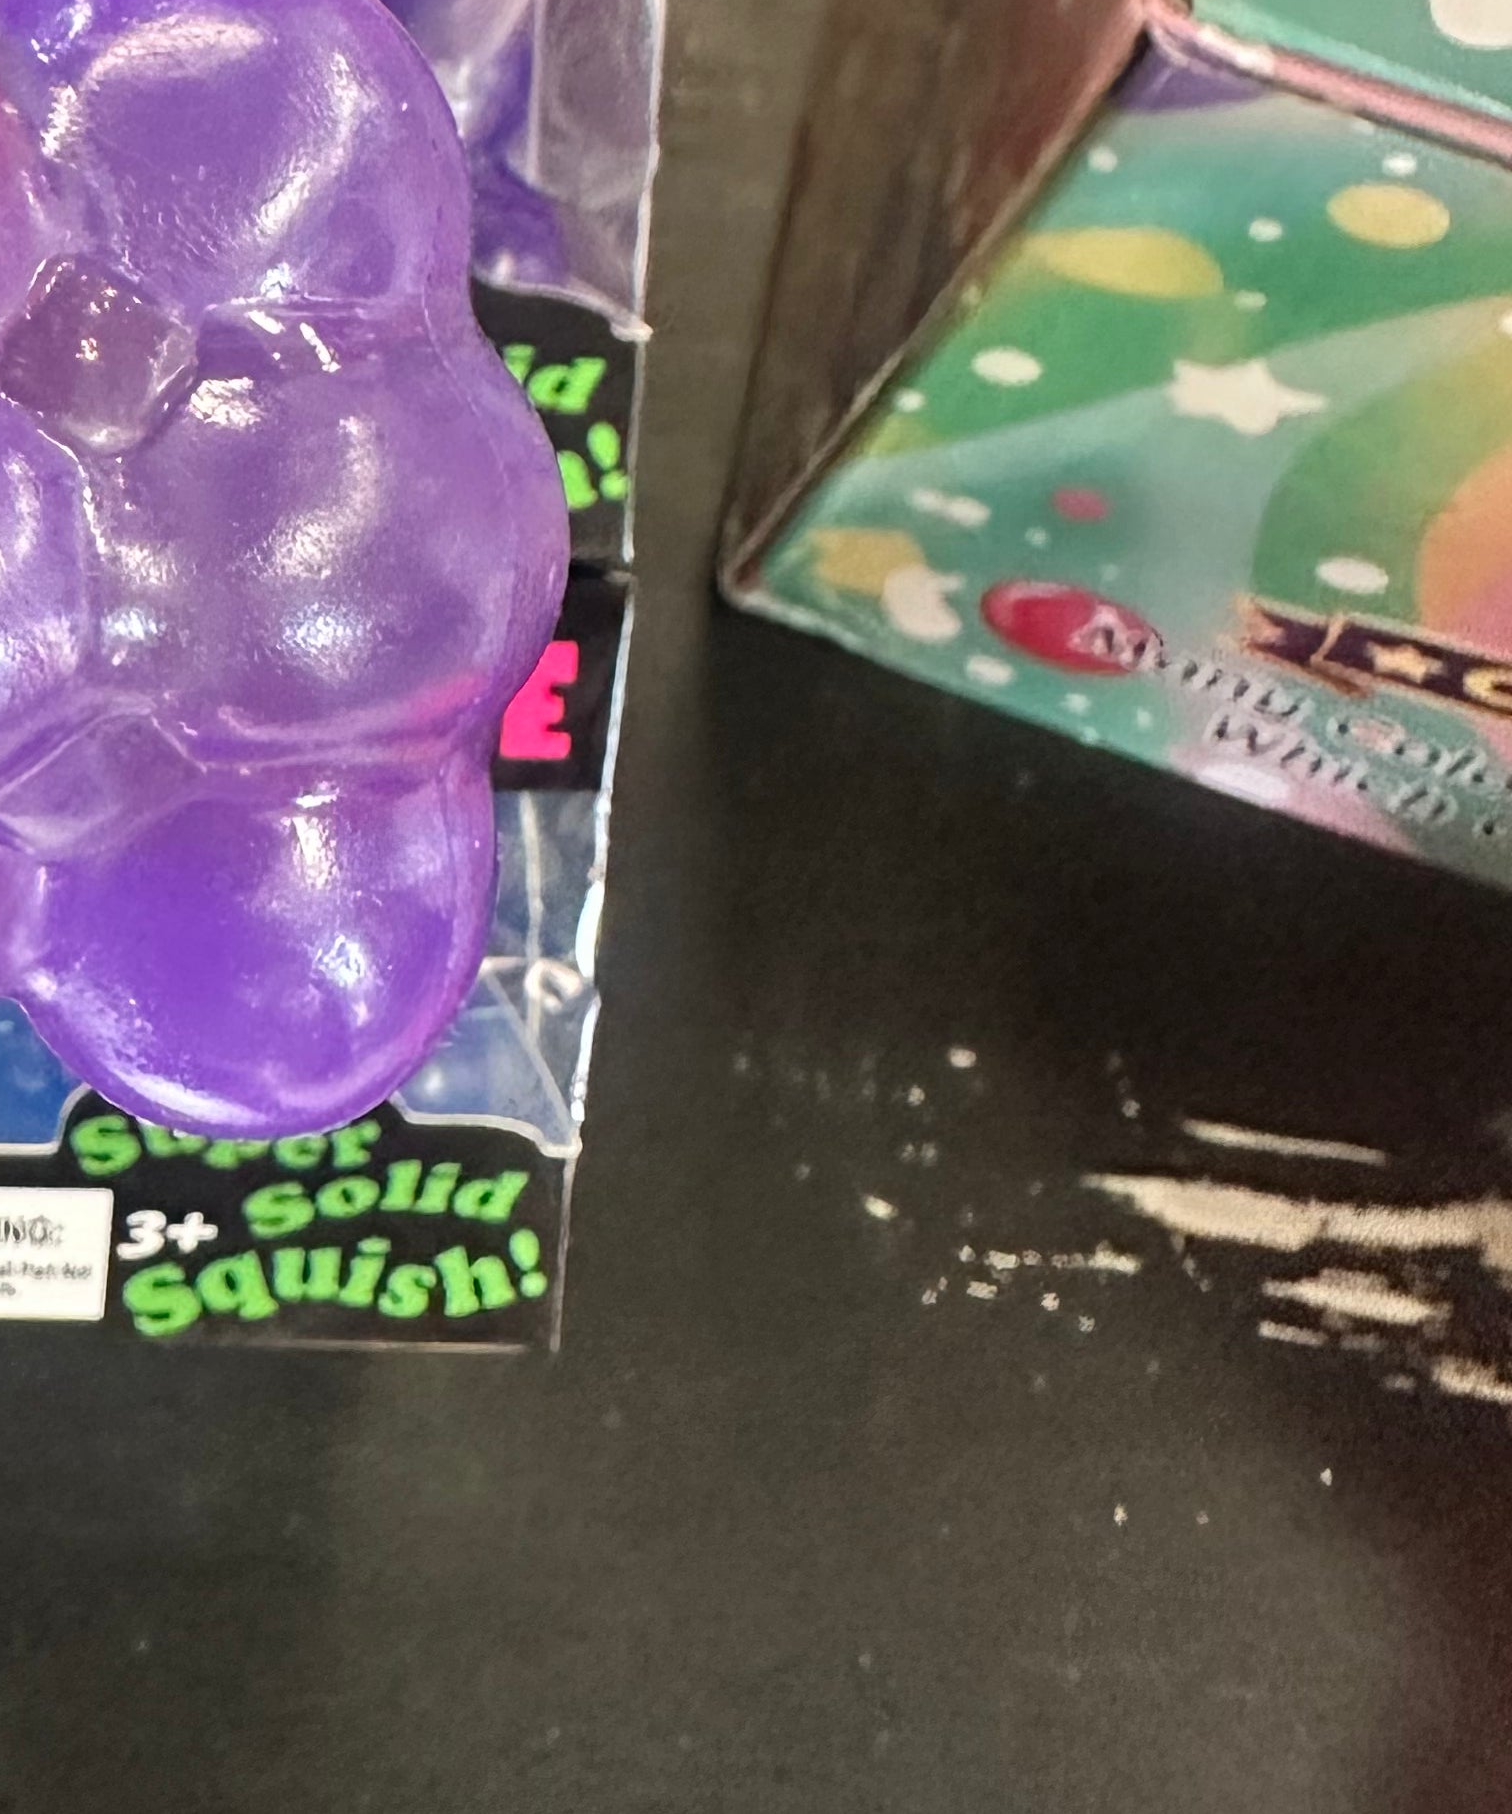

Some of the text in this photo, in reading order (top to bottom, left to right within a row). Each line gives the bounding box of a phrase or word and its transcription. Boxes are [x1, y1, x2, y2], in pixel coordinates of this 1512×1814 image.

[117, 1208, 220, 1262] 3+
[242, 1161, 531, 1240] Solid
[122, 1228, 549, 1339] Squish!
